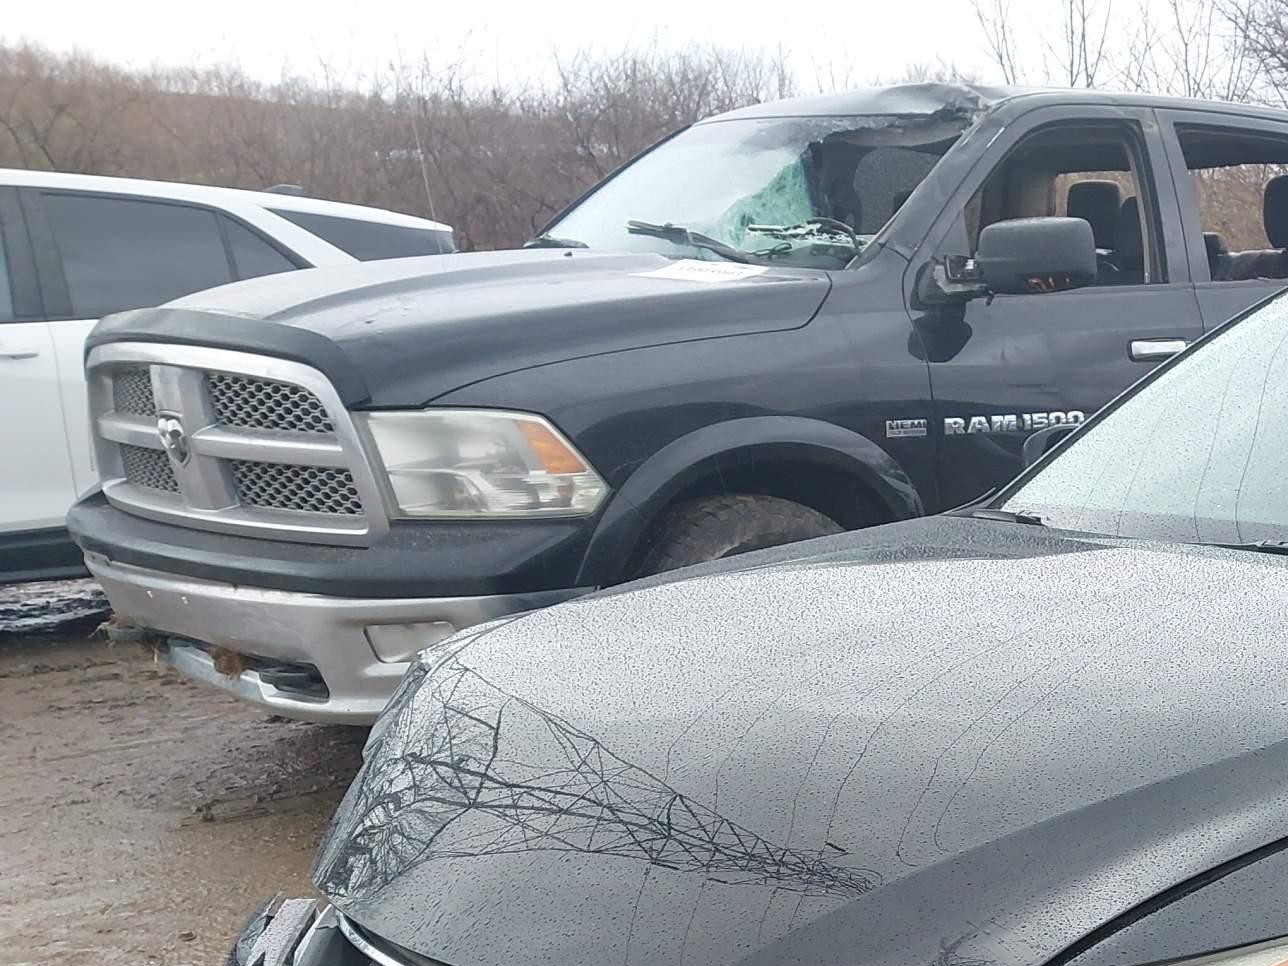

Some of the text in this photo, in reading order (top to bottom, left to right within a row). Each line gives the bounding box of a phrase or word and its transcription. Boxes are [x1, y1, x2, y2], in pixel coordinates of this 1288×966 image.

[886, 419, 928, 431] HEMI
[944, 411, 1086, 436] RAM 1500
